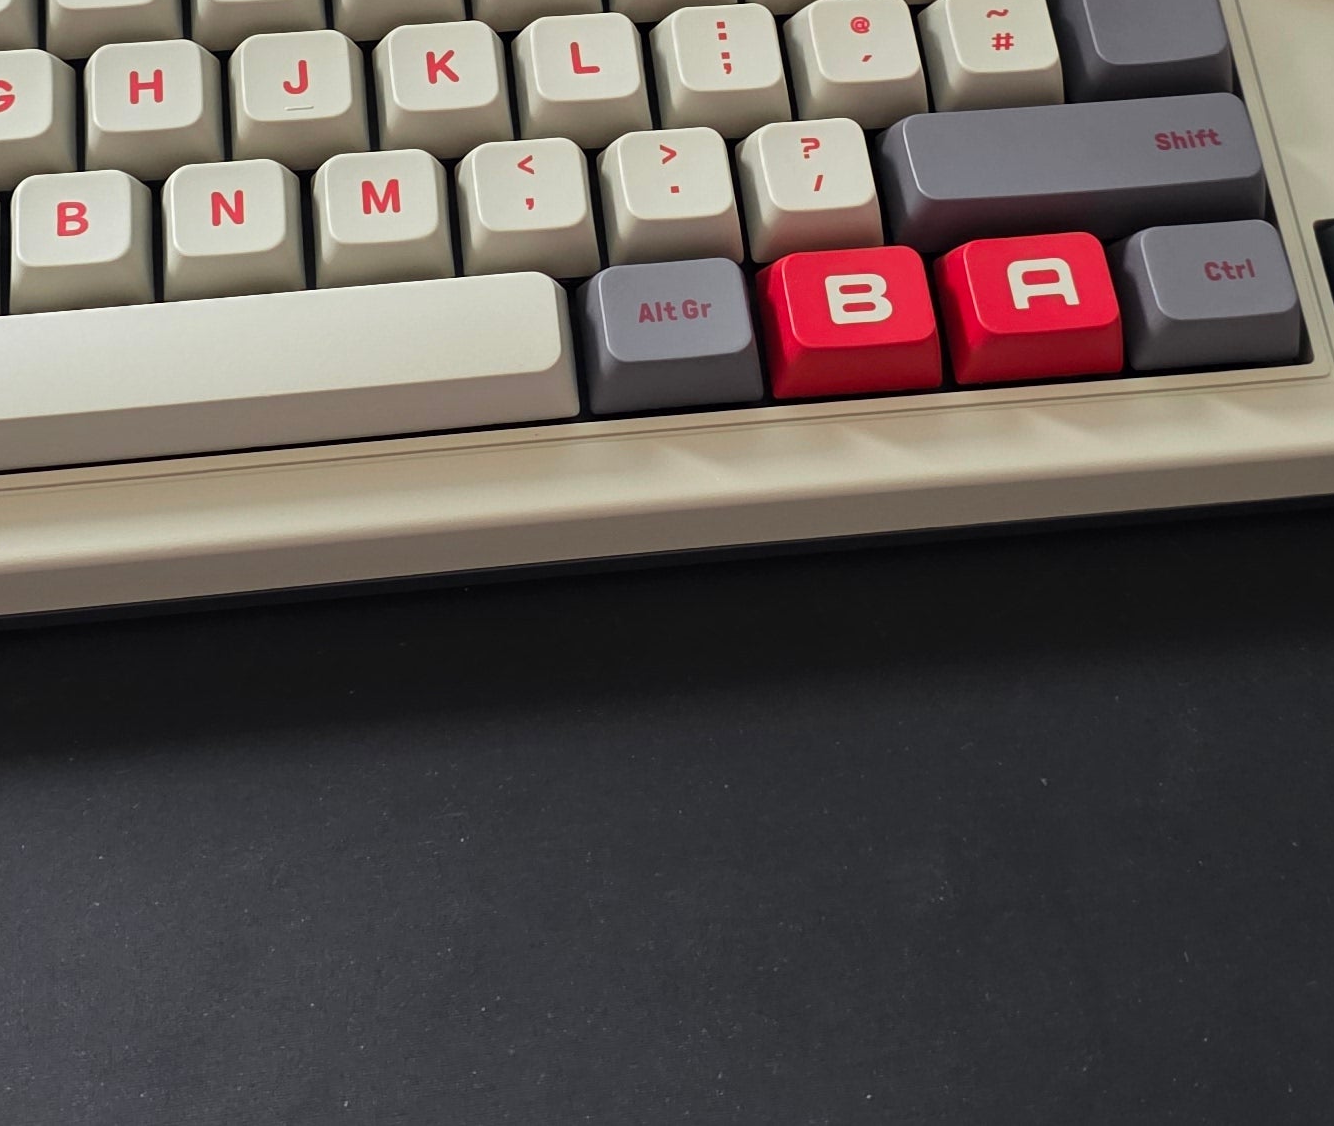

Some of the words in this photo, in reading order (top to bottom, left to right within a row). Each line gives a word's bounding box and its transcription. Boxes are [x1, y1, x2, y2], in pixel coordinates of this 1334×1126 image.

[849, 16, 871, 35] @
[986, 8, 1010, 19] ~
[715, 20, 728, 42] :
[992, 32, 1014, 51] #
[426, 50, 459, 84] K
[570, 42, 601, 75] L
[720, 50, 733, 75] ;
[129, 69, 164, 105] H
[282, 59, 309, 95] J
[800, 136, 822, 159] ?
[1154, 129, 1221, 151] Shift
[517, 155, 535, 175] <
[659, 144, 678, 165] >
[669, 184, 681, 195] .
[813, 174, 824, 192] /
[210, 189, 245, 227] N
[361, 178, 401, 215] M
[56, 201, 89, 237] B
[1204, 260, 1255, 282] Ctrl
[1006, 257, 1081, 310] A
[638, 302, 677, 323] Alt
[681, 298, 710, 320] Gr
[825, 273, 894, 326] B
